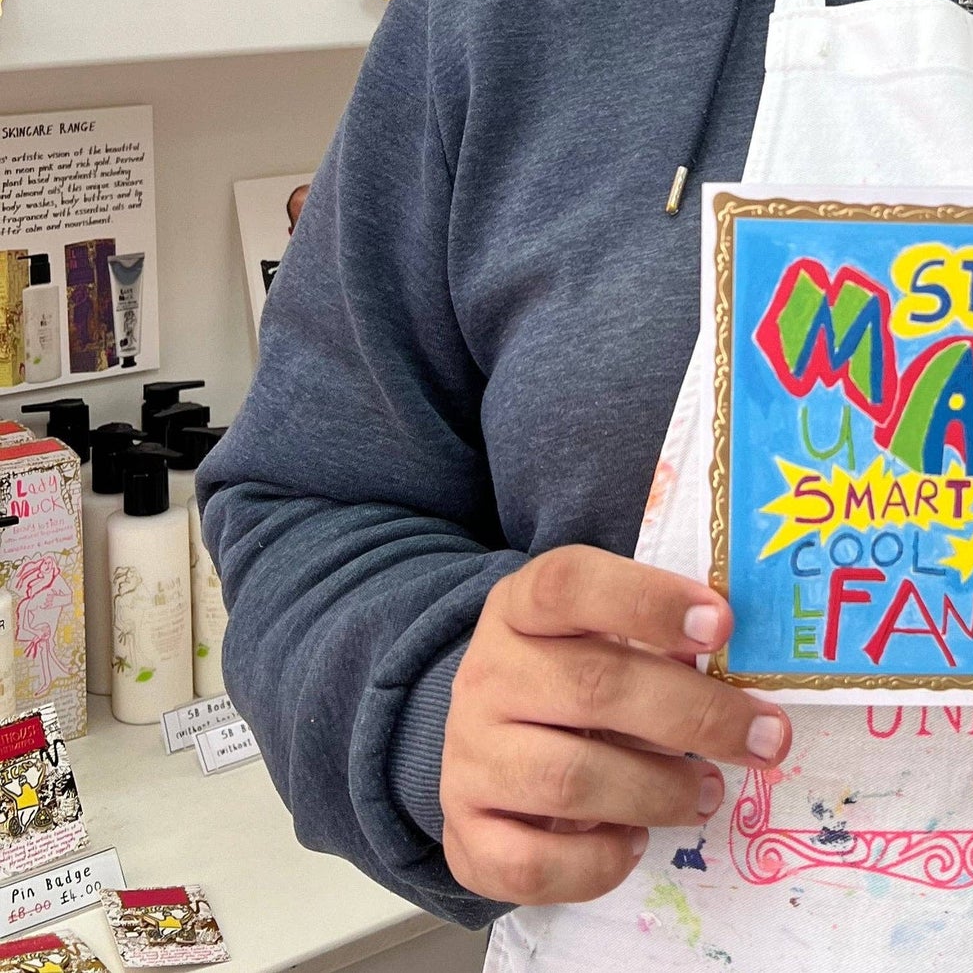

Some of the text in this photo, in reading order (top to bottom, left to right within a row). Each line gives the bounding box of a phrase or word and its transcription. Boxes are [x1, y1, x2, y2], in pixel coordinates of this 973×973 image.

[2, 120, 97, 140] SKINCARE RANGE
[11, 151, 44, 163] artistic
[73, 147, 83, 157] of
[89, 144, 101, 156] the
[105, 141, 140, 154] beautiful
[15, 166, 35, 175] neon
[57, 158, 73, 170] and
[2, 176, 23, 193] plant
[27, 173, 50, 185] based
[15, 186, 45, 198] almond
[2, 201, 21, 215] body
[61, 191, 80, 208] body
[116, 187, 131, 199] and
[0, 226, 22, 236] ffer
[25, 223, 43, 234] calm
[46, 219, 62, 231] and
[789, 531, 948, 579] COOL
[207, 699, 232, 714] Body
[12, 866, 92, 903] Pin Badge
[8, 880, 102, 924] £8.00 £4.00
